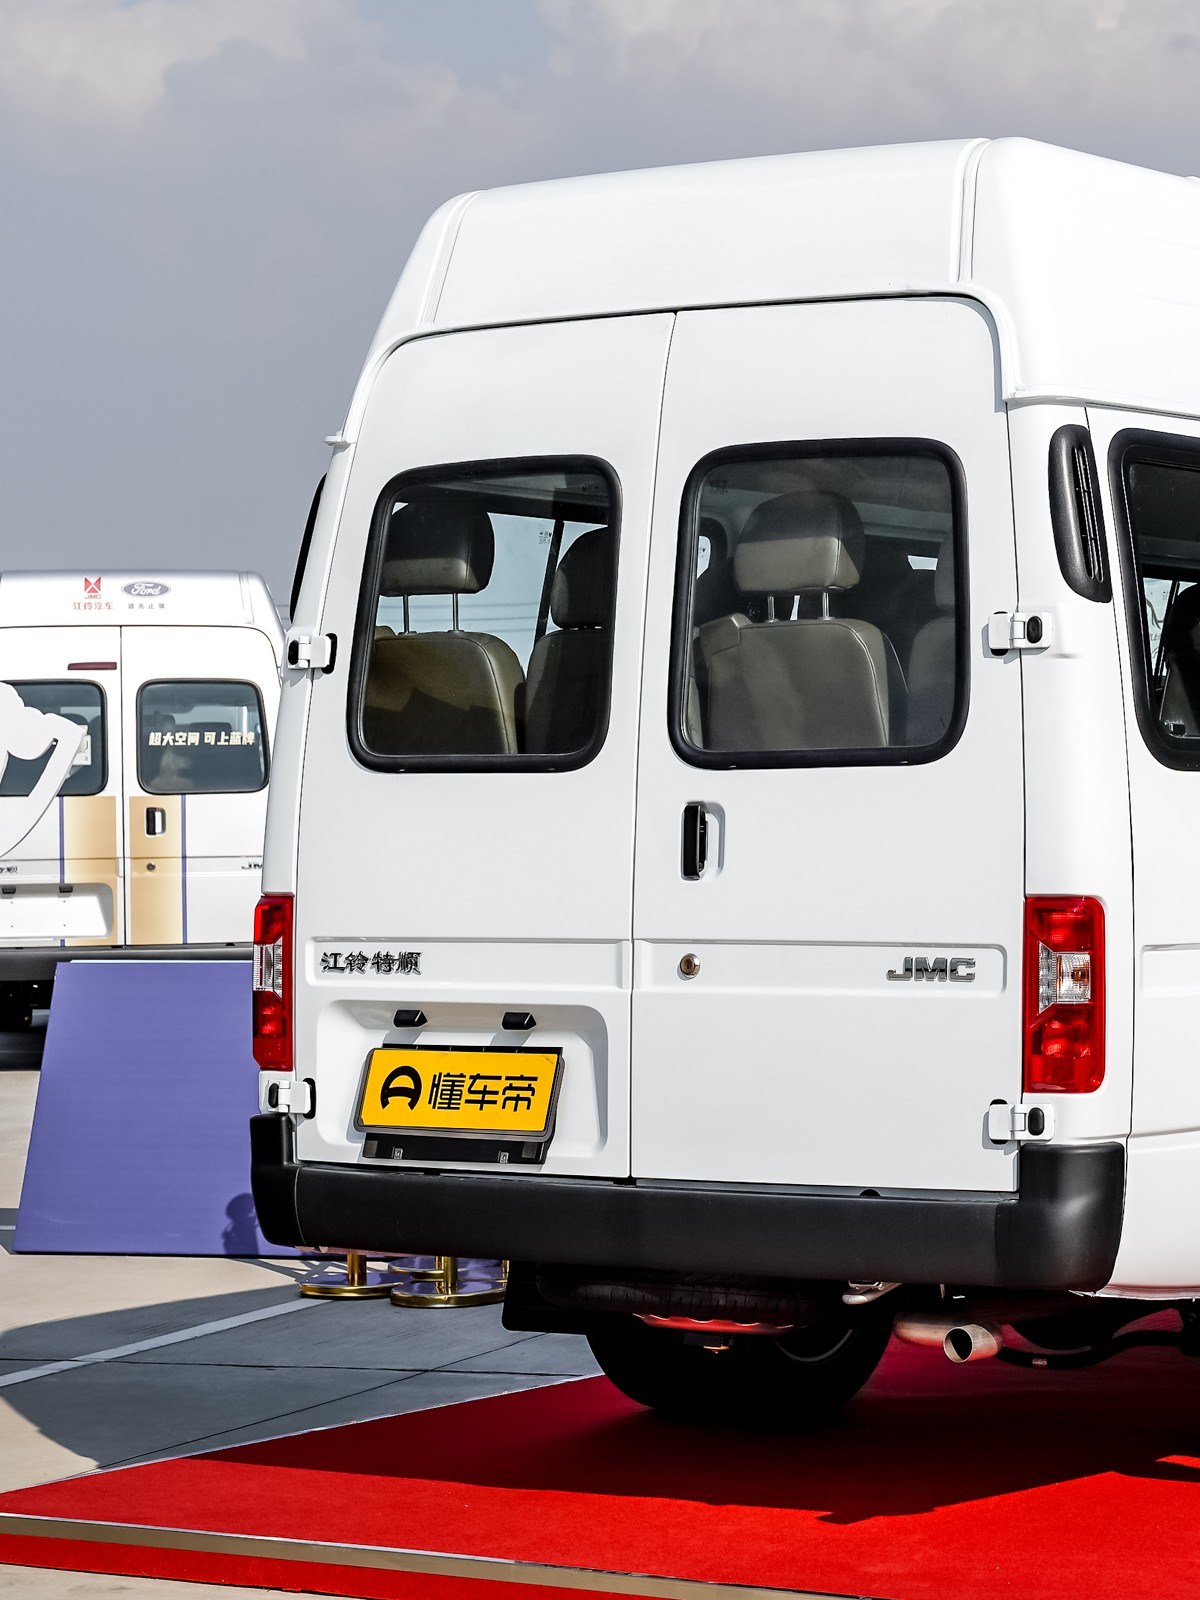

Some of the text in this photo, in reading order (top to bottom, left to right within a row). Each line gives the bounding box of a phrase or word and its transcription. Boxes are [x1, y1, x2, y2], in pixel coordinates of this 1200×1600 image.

[148, 731, 200, 746] 超大空间
[320, 951, 422, 974] 江铃特顺
[886, 956, 976, 982] JMC
[428, 1072, 539, 1112] 懂车帝
